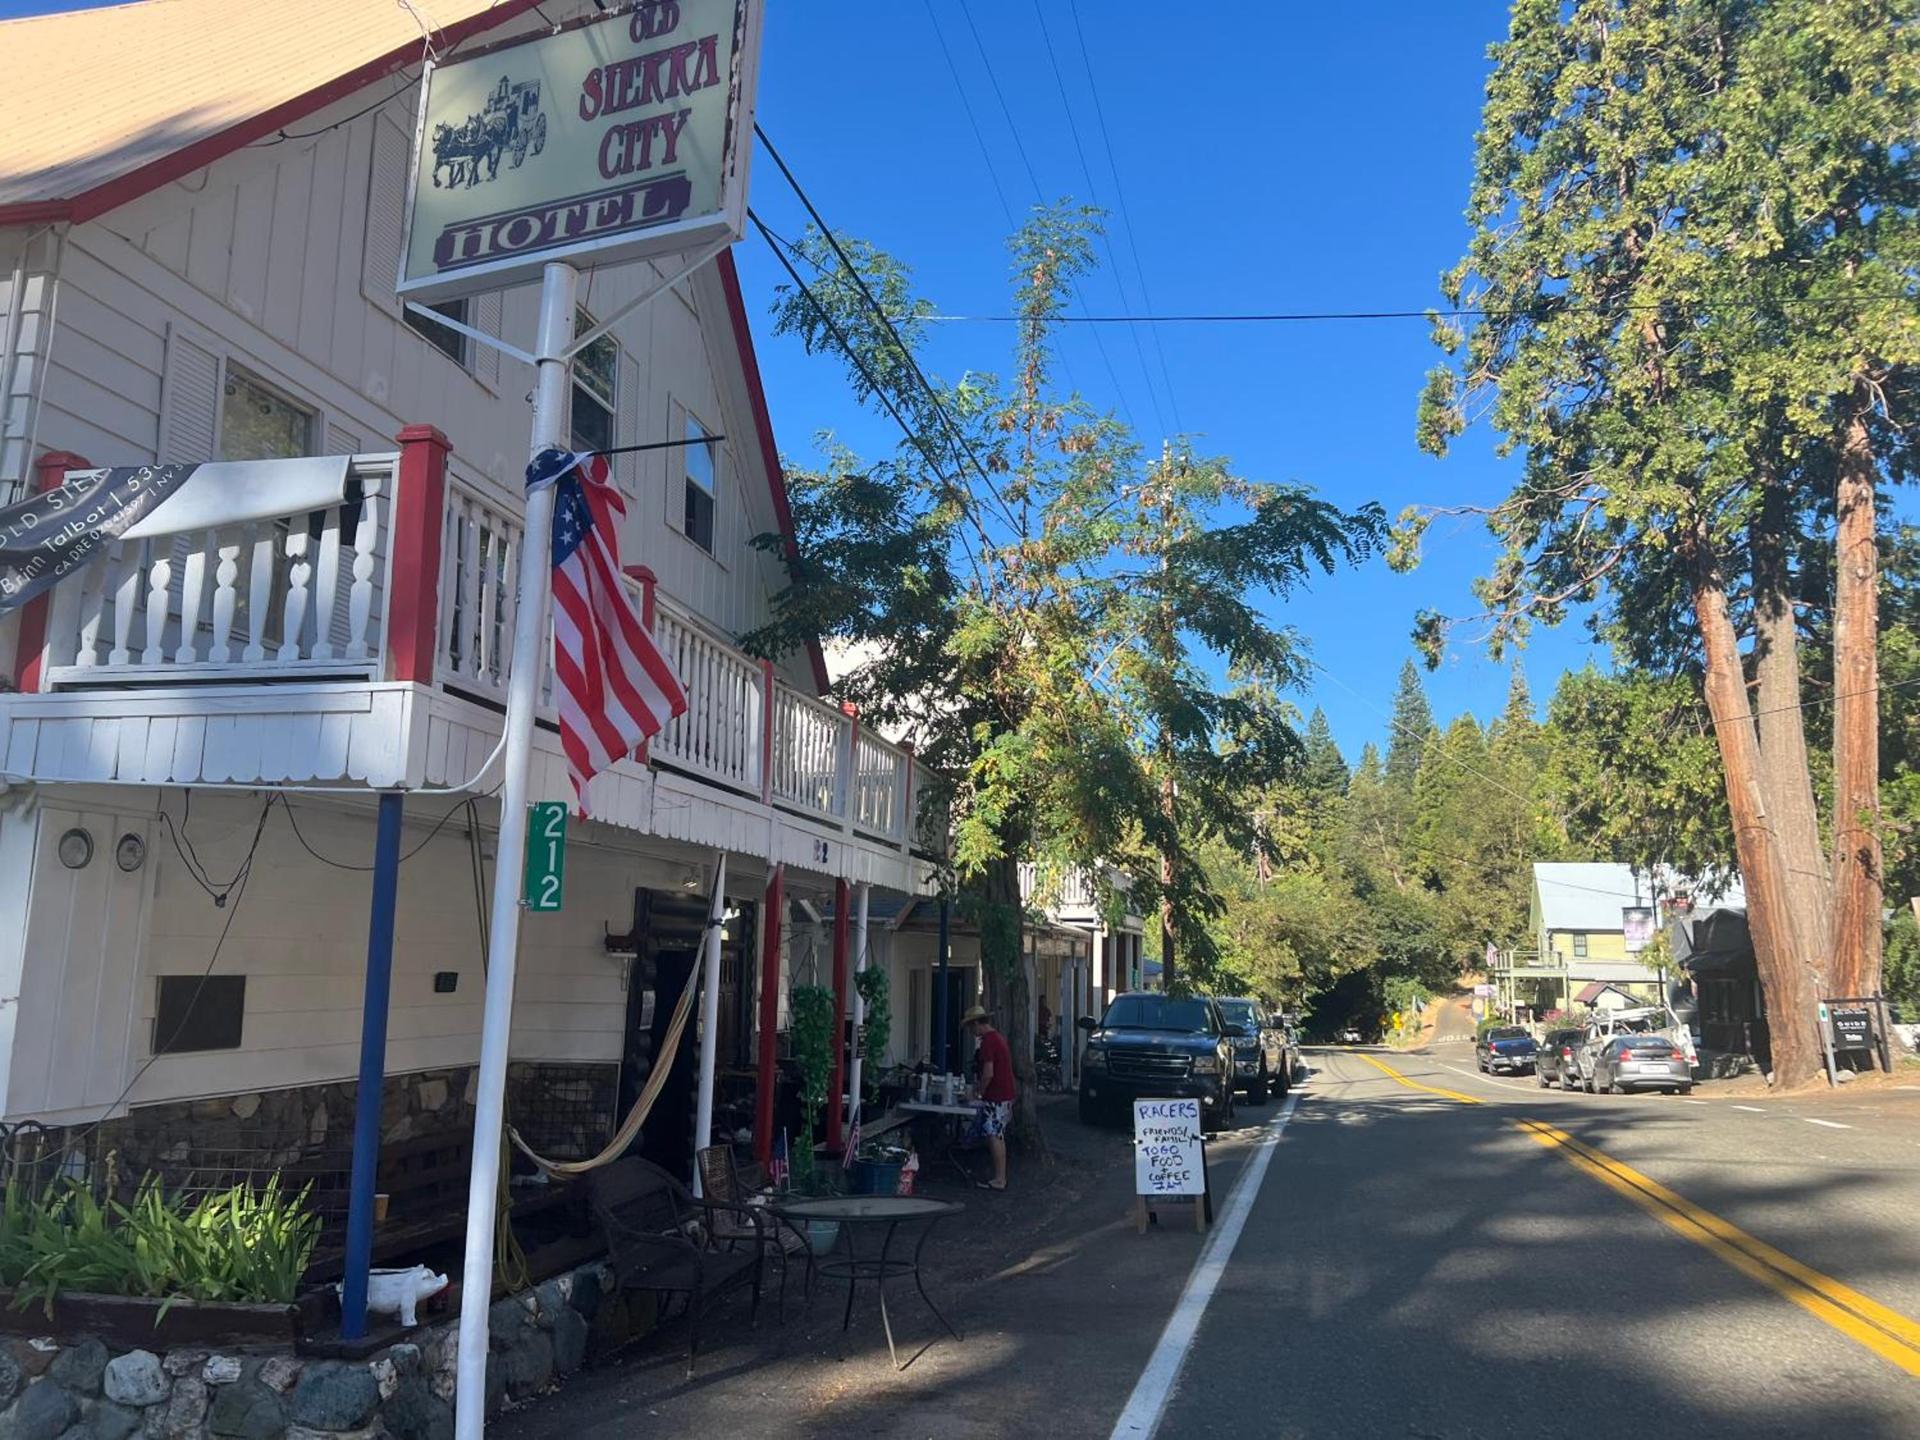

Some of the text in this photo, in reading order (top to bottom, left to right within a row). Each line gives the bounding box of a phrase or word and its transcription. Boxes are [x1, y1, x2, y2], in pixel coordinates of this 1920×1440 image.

[629, 0, 680, 43] OLD
[578, 33, 720, 122] SIERRA
[598, 108, 692, 180] CITY
[447, 188, 671, 262] HOTEL
[0, 555, 47, 594] Brinn
[41, 505, 106, 553] Talbot
[54, 560, 72, 576] CA
[68, 538, 92, 561] DRE
[540, 805, 564, 908] 212
[1139, 1102, 1198, 1120] RACERS
[1148, 1170, 1190, 1181] COFFEE
[1151, 1155, 1183, 1167] FOOD
